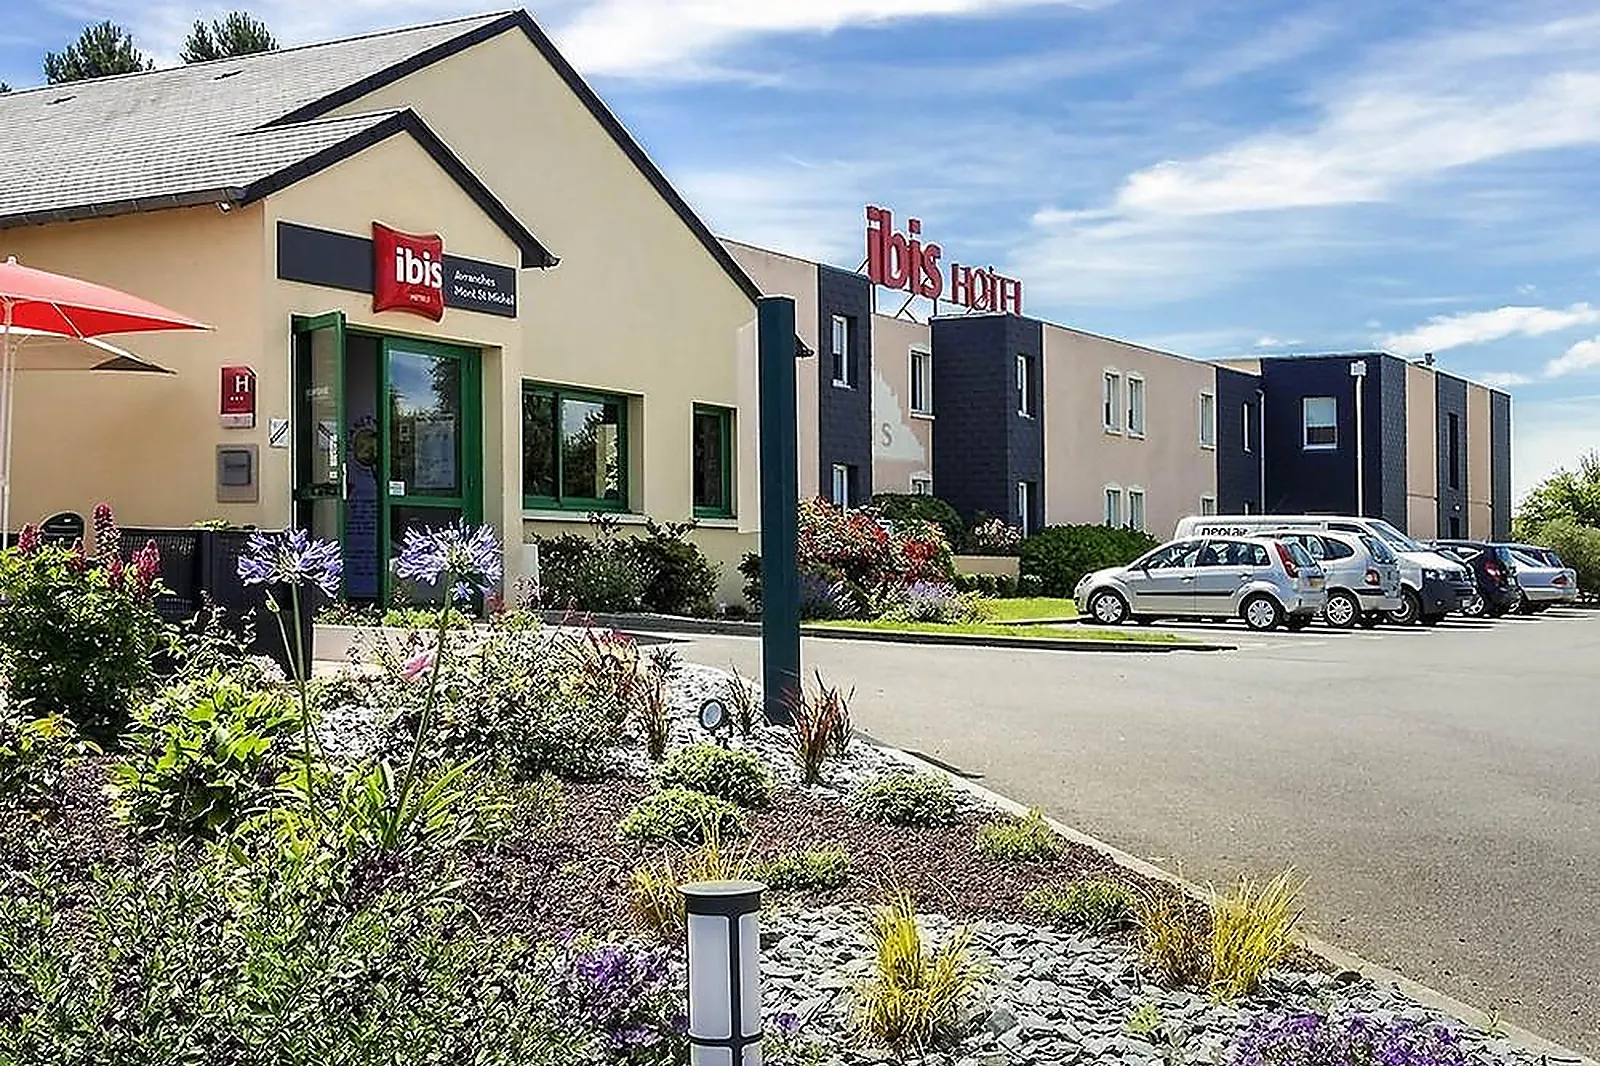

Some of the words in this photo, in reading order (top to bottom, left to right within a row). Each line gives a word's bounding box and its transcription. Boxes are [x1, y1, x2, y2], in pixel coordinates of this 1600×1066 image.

[395, 246, 443, 289] ibis
[866, 205, 942, 299] ibis
[235, 374, 249, 393] H
[881, 422, 892, 447] S
